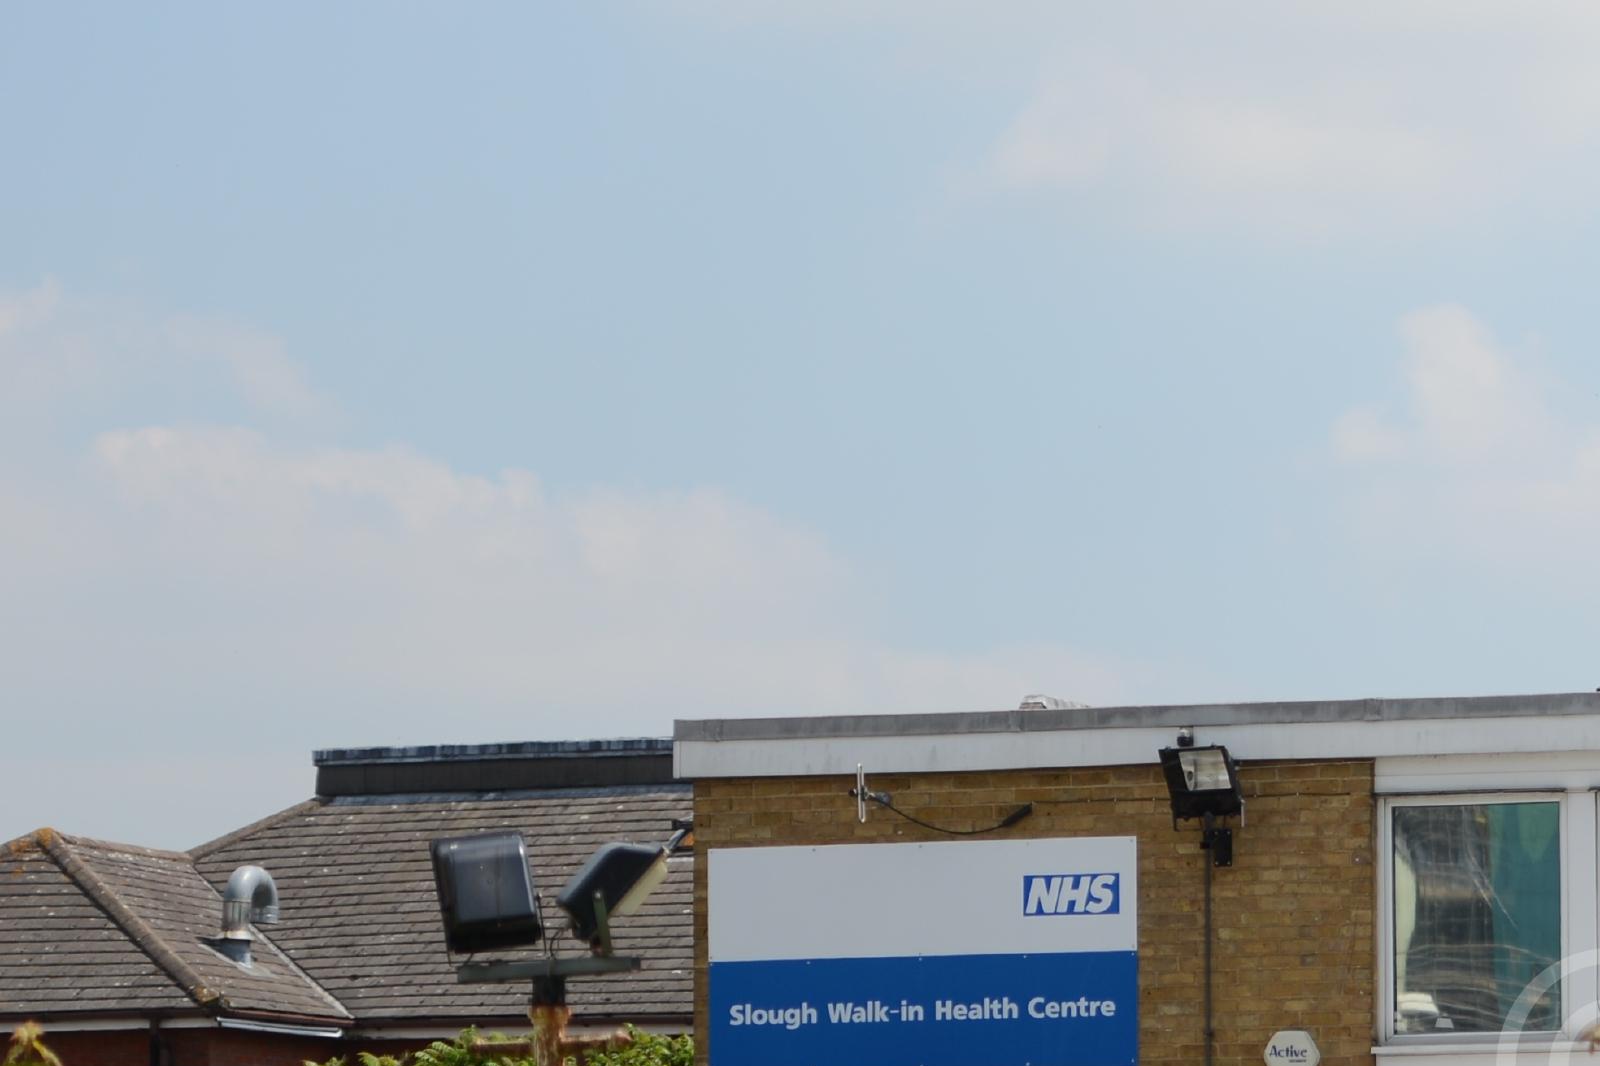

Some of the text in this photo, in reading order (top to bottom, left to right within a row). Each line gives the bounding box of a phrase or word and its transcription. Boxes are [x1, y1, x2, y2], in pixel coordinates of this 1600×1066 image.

[1025, 875, 1117, 915] NHS
[729, 996, 1117, 1030] Slough Walk-in Health Centre
[1269, 1045, 1308, 1058] Active
